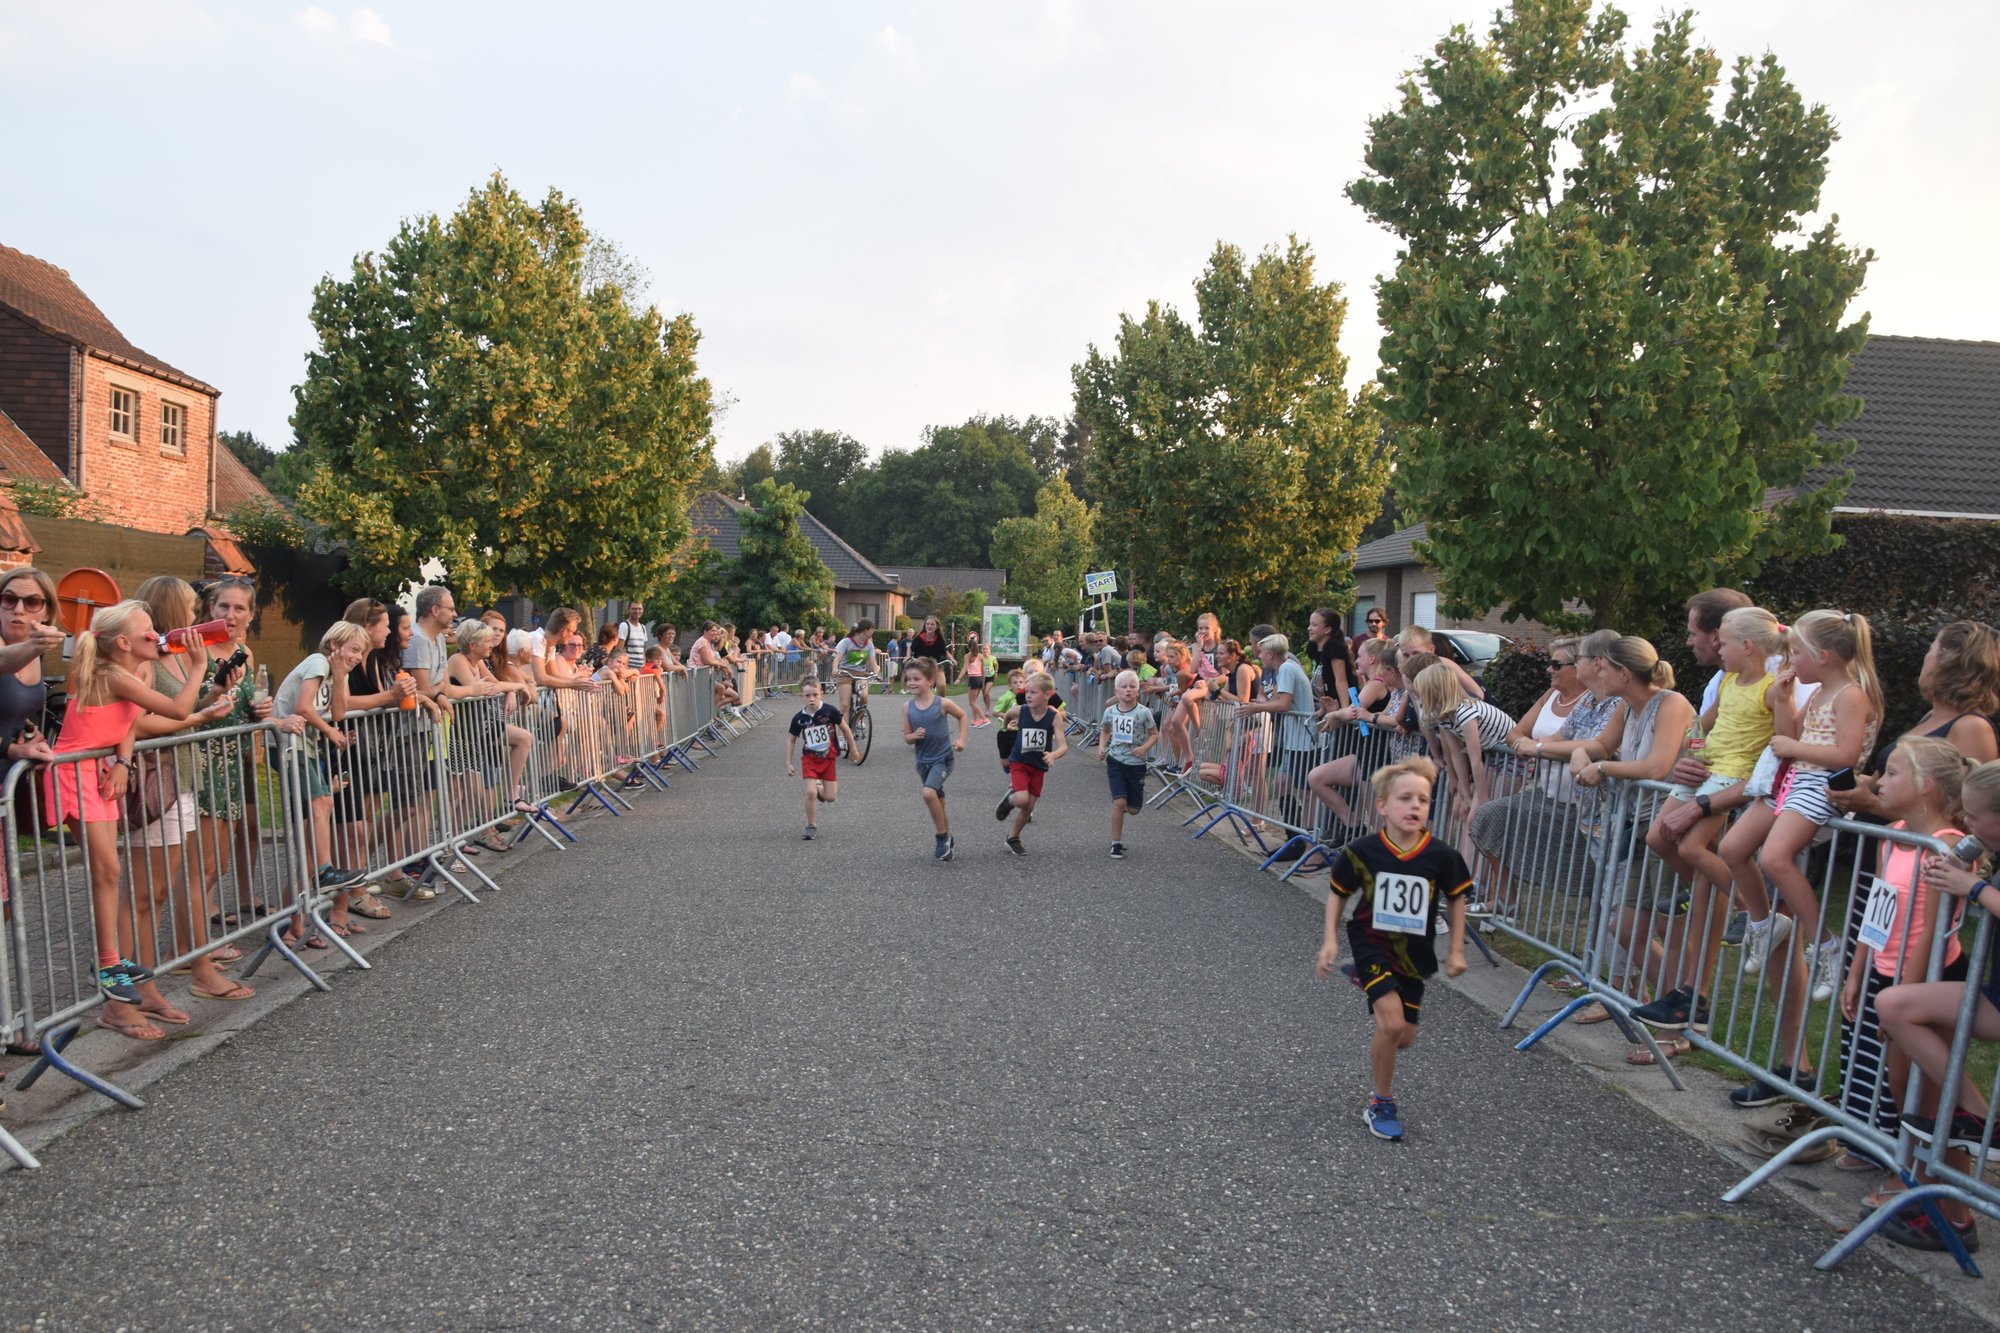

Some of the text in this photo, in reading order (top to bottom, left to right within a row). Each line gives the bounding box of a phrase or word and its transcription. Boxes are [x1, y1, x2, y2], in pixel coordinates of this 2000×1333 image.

[1088, 576, 1115, 590] START
[1114, 717, 1132, 734] 145
[808, 727, 828, 745] 138
[1024, 730, 1046, 747] 143
[1379, 877, 1424, 916] 130
[1872, 885, 1897, 931] 170
